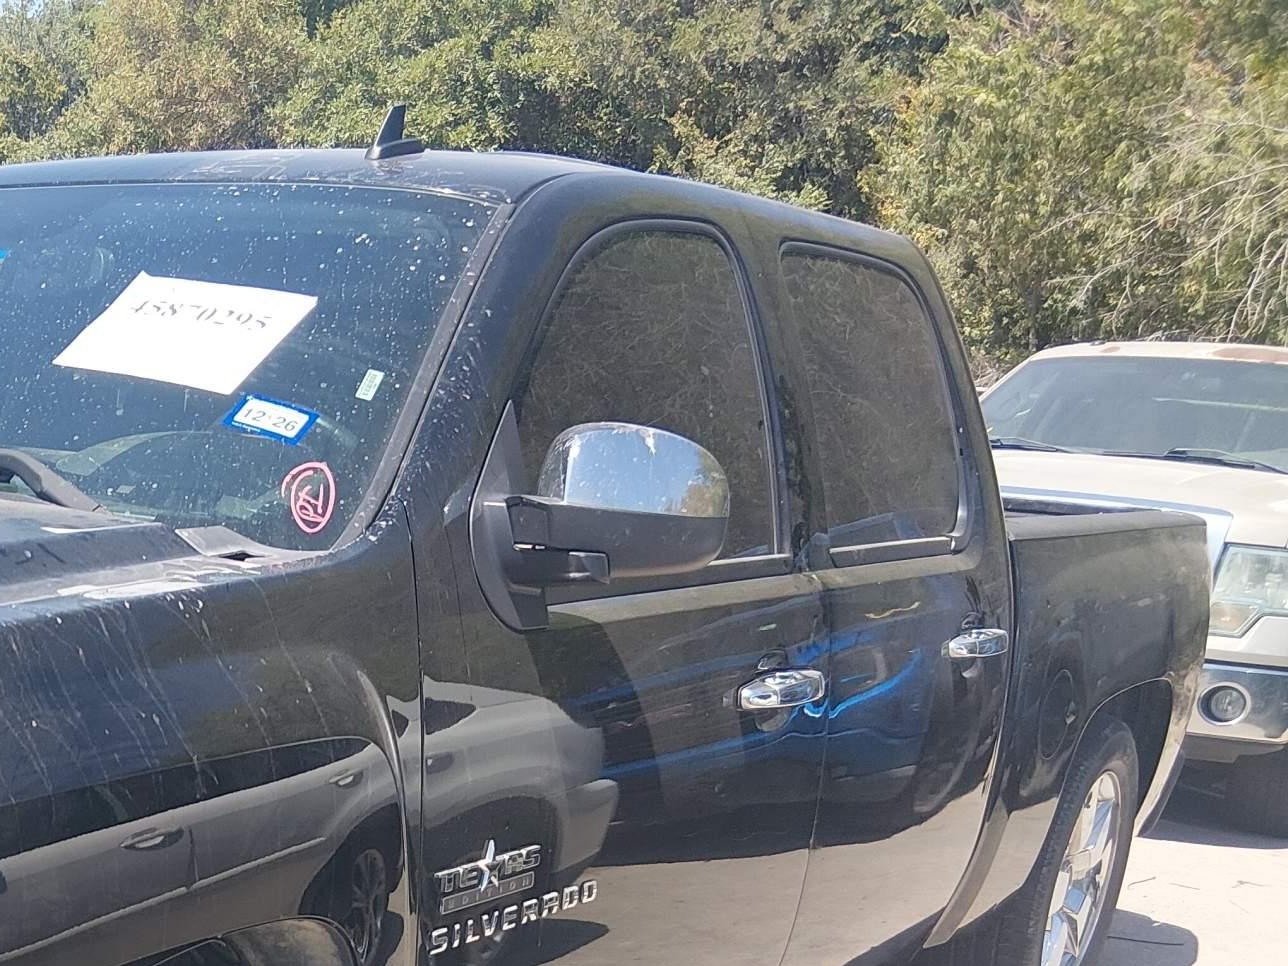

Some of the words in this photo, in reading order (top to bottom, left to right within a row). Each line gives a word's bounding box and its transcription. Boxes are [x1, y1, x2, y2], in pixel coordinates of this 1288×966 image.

[433, 840, 542, 893] TEXAS
[429, 880, 598, 956] SILVERADO
[447, 877, 532, 910] EDITION
